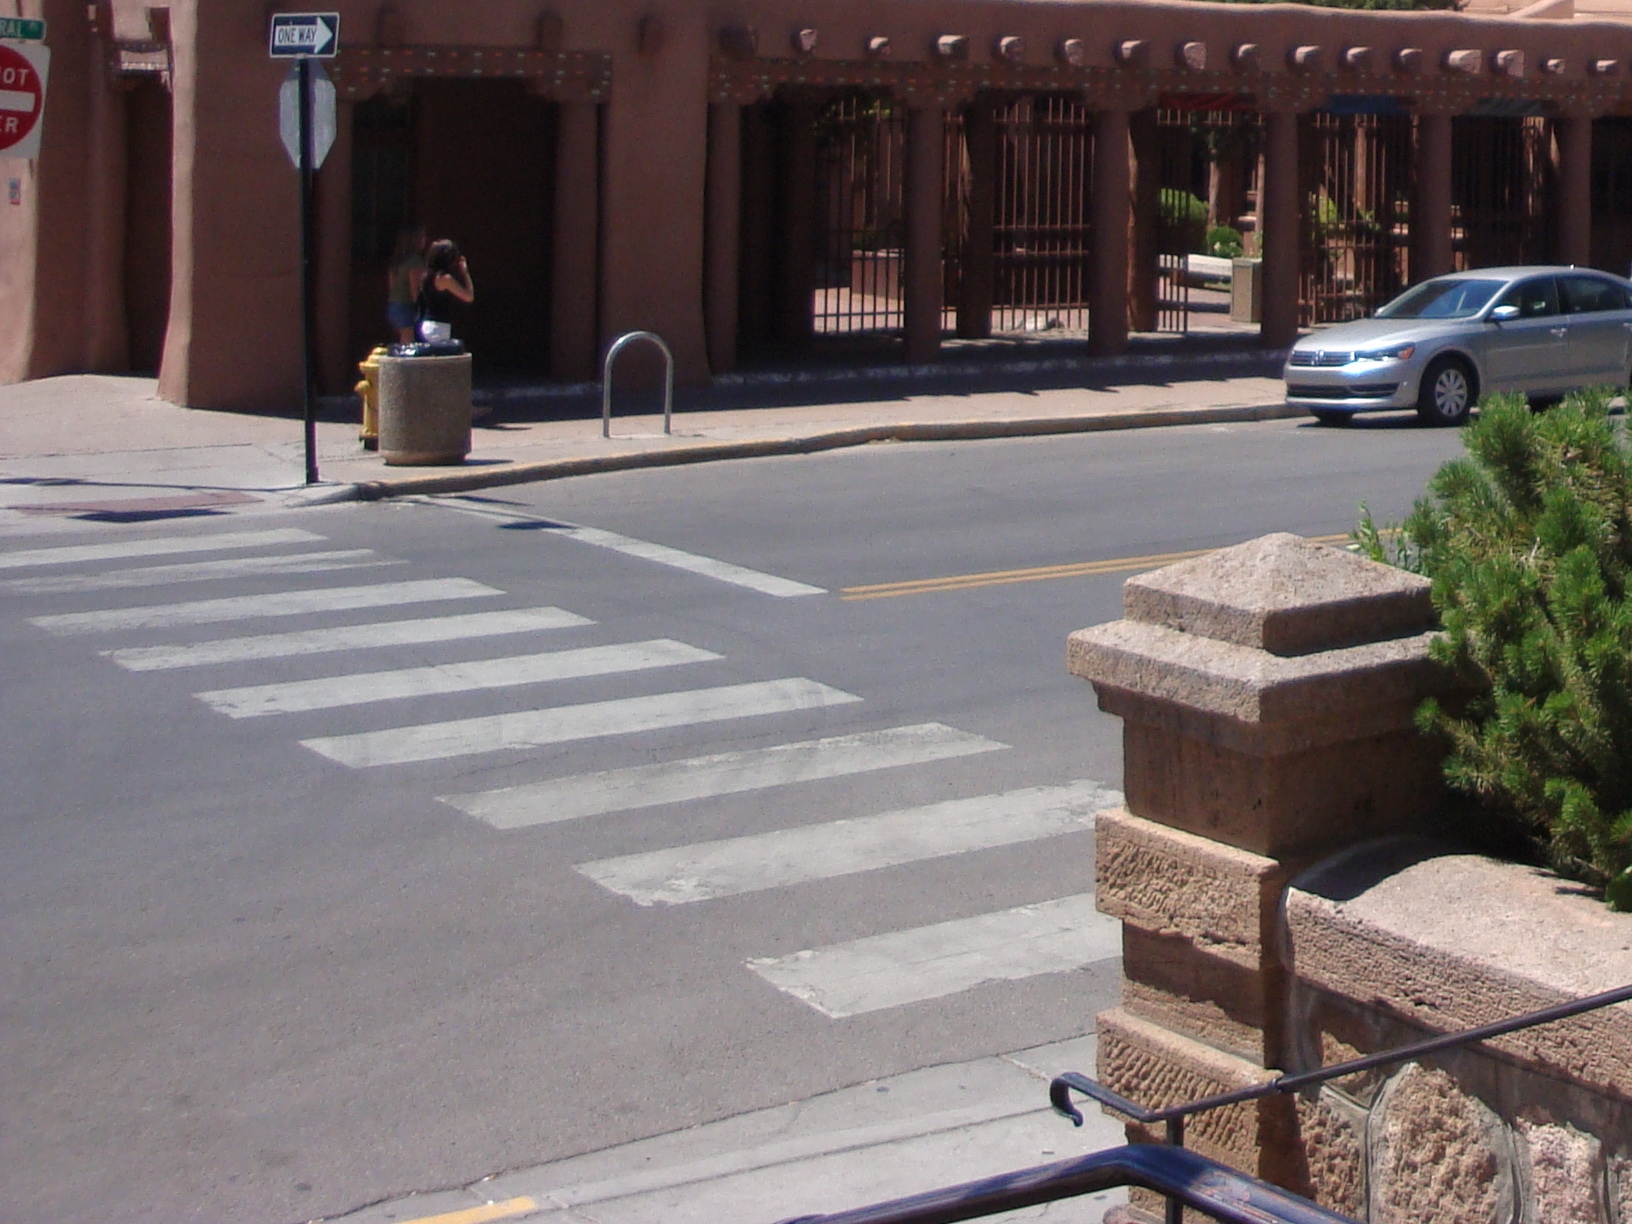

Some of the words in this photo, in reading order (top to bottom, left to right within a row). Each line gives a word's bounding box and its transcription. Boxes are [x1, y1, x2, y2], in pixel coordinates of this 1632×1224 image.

[278, 27, 297, 44] ONE
[298, 27, 317, 44] WAY
[0, 66, 30, 87] OT
